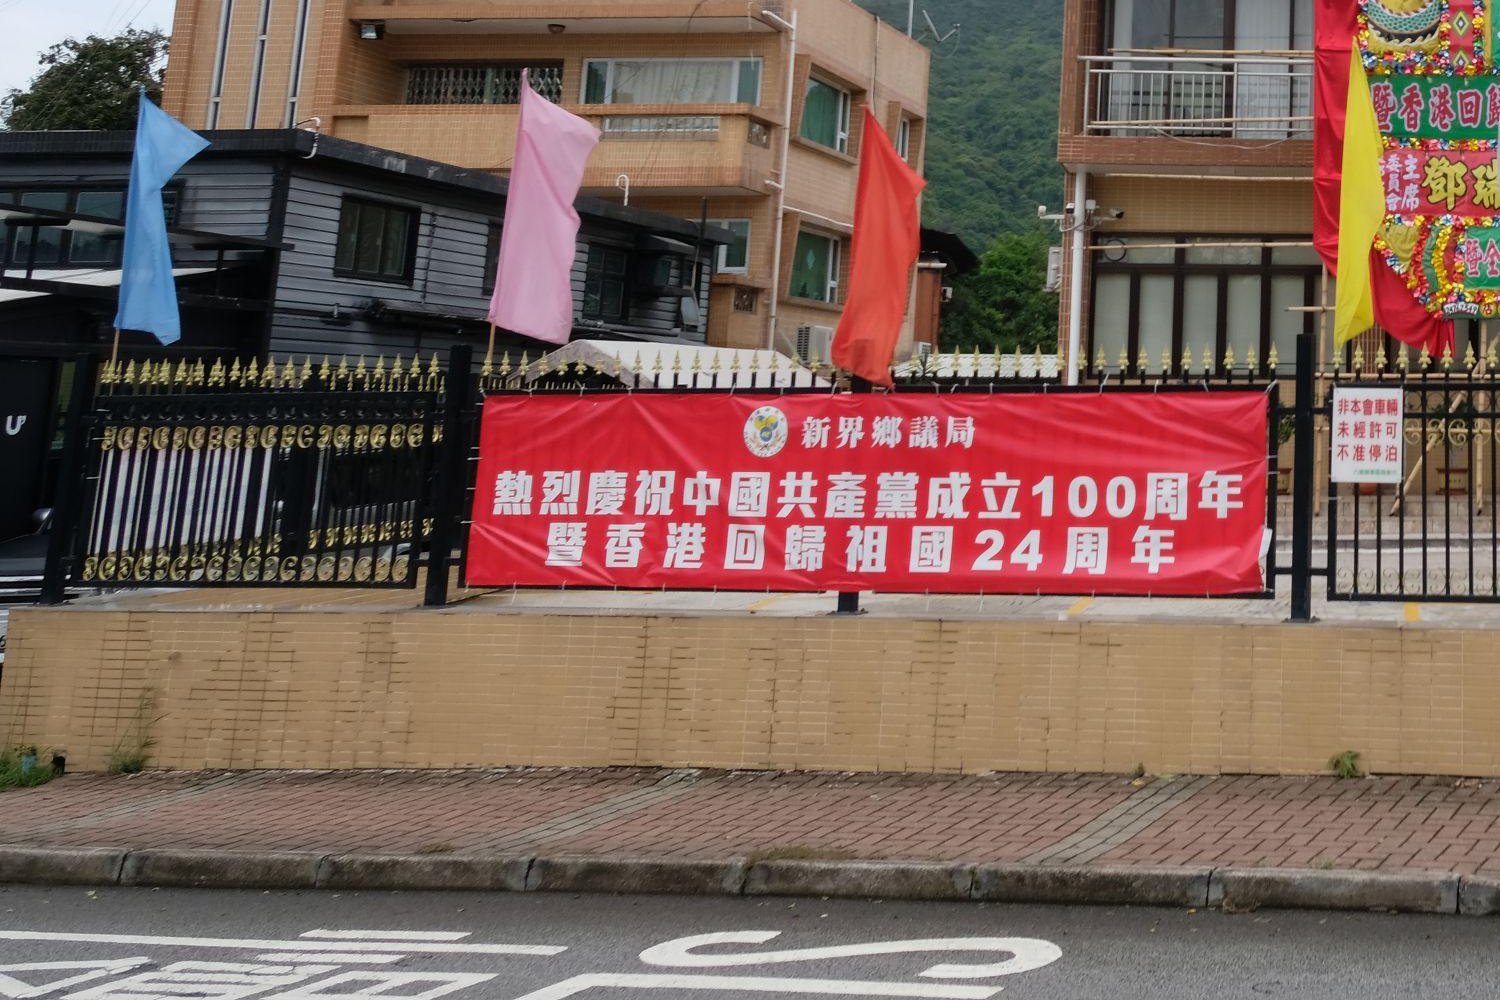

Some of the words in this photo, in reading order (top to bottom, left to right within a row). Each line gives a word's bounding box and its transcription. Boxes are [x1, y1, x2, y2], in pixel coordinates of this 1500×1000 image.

[1338, 398, 1398, 416] 非本會車輛
[801, 415, 976, 449] 新界鄉議局
[1337, 421, 1398, 439] 未經許可
[1336, 443, 1398, 462] 不准停泊
[493, 469, 1244, 521] 熱烈慶祝中國共產黨成立100周年
[544, 522, 1176, 575] 暨香港回歸祖國24周年
